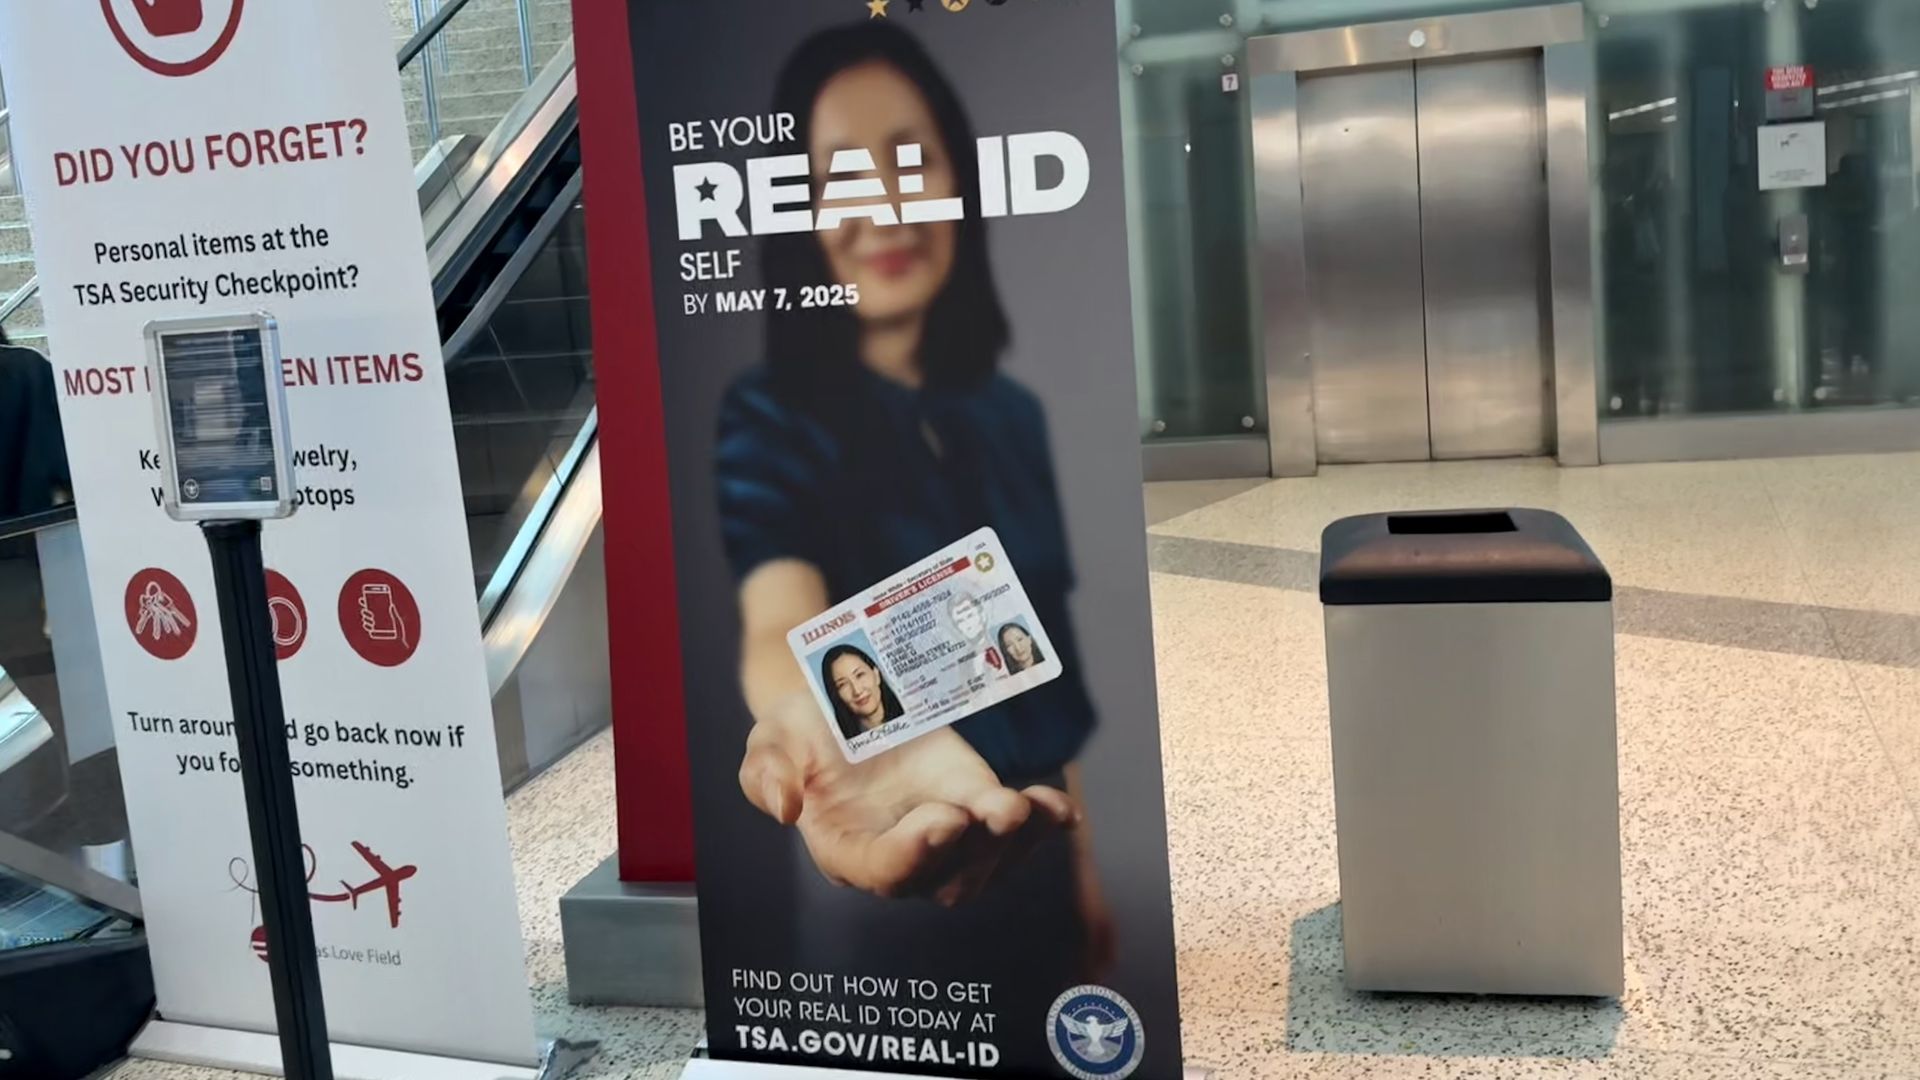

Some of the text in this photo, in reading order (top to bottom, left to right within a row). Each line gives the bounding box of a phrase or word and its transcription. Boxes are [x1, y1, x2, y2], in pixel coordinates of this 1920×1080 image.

[669, 112, 796, 152] BE YOUR
[54, 118, 368, 186] DID YOU FORGET?
[672, 130, 1091, 241] REAL ID
[94, 223, 329, 264] Personal items at the
[679, 249, 742, 282] SELF
[73, 264, 359, 306] TSA Security Checkpoint?
[683, 284, 861, 315] BY MAY 7, 2025
[63, 366, 136, 396] MOST
[327, 352, 424, 385] ITEMS
[801, 610, 857, 646] ILLINOIS
[127, 712, 174, 733] Turn
[179, 717, 236, 738] aroun
[305, 729, 330, 746] go
[335, 721, 389, 745] back
[394, 729, 441, 747] now
[448, 725, 465, 748] if
[177, 752, 214, 775] you
[290, 759, 415, 789] something.
[333, 947, 364, 962] Love
[367, 949, 401, 966] Field
[732, 968, 992, 1003] FIND OUT HOW TO GET
[734, 996, 997, 1033] YOUR REAL ID TODAY AT
[735, 1024, 1000, 1068] TSA.GOV/REAL-ID
